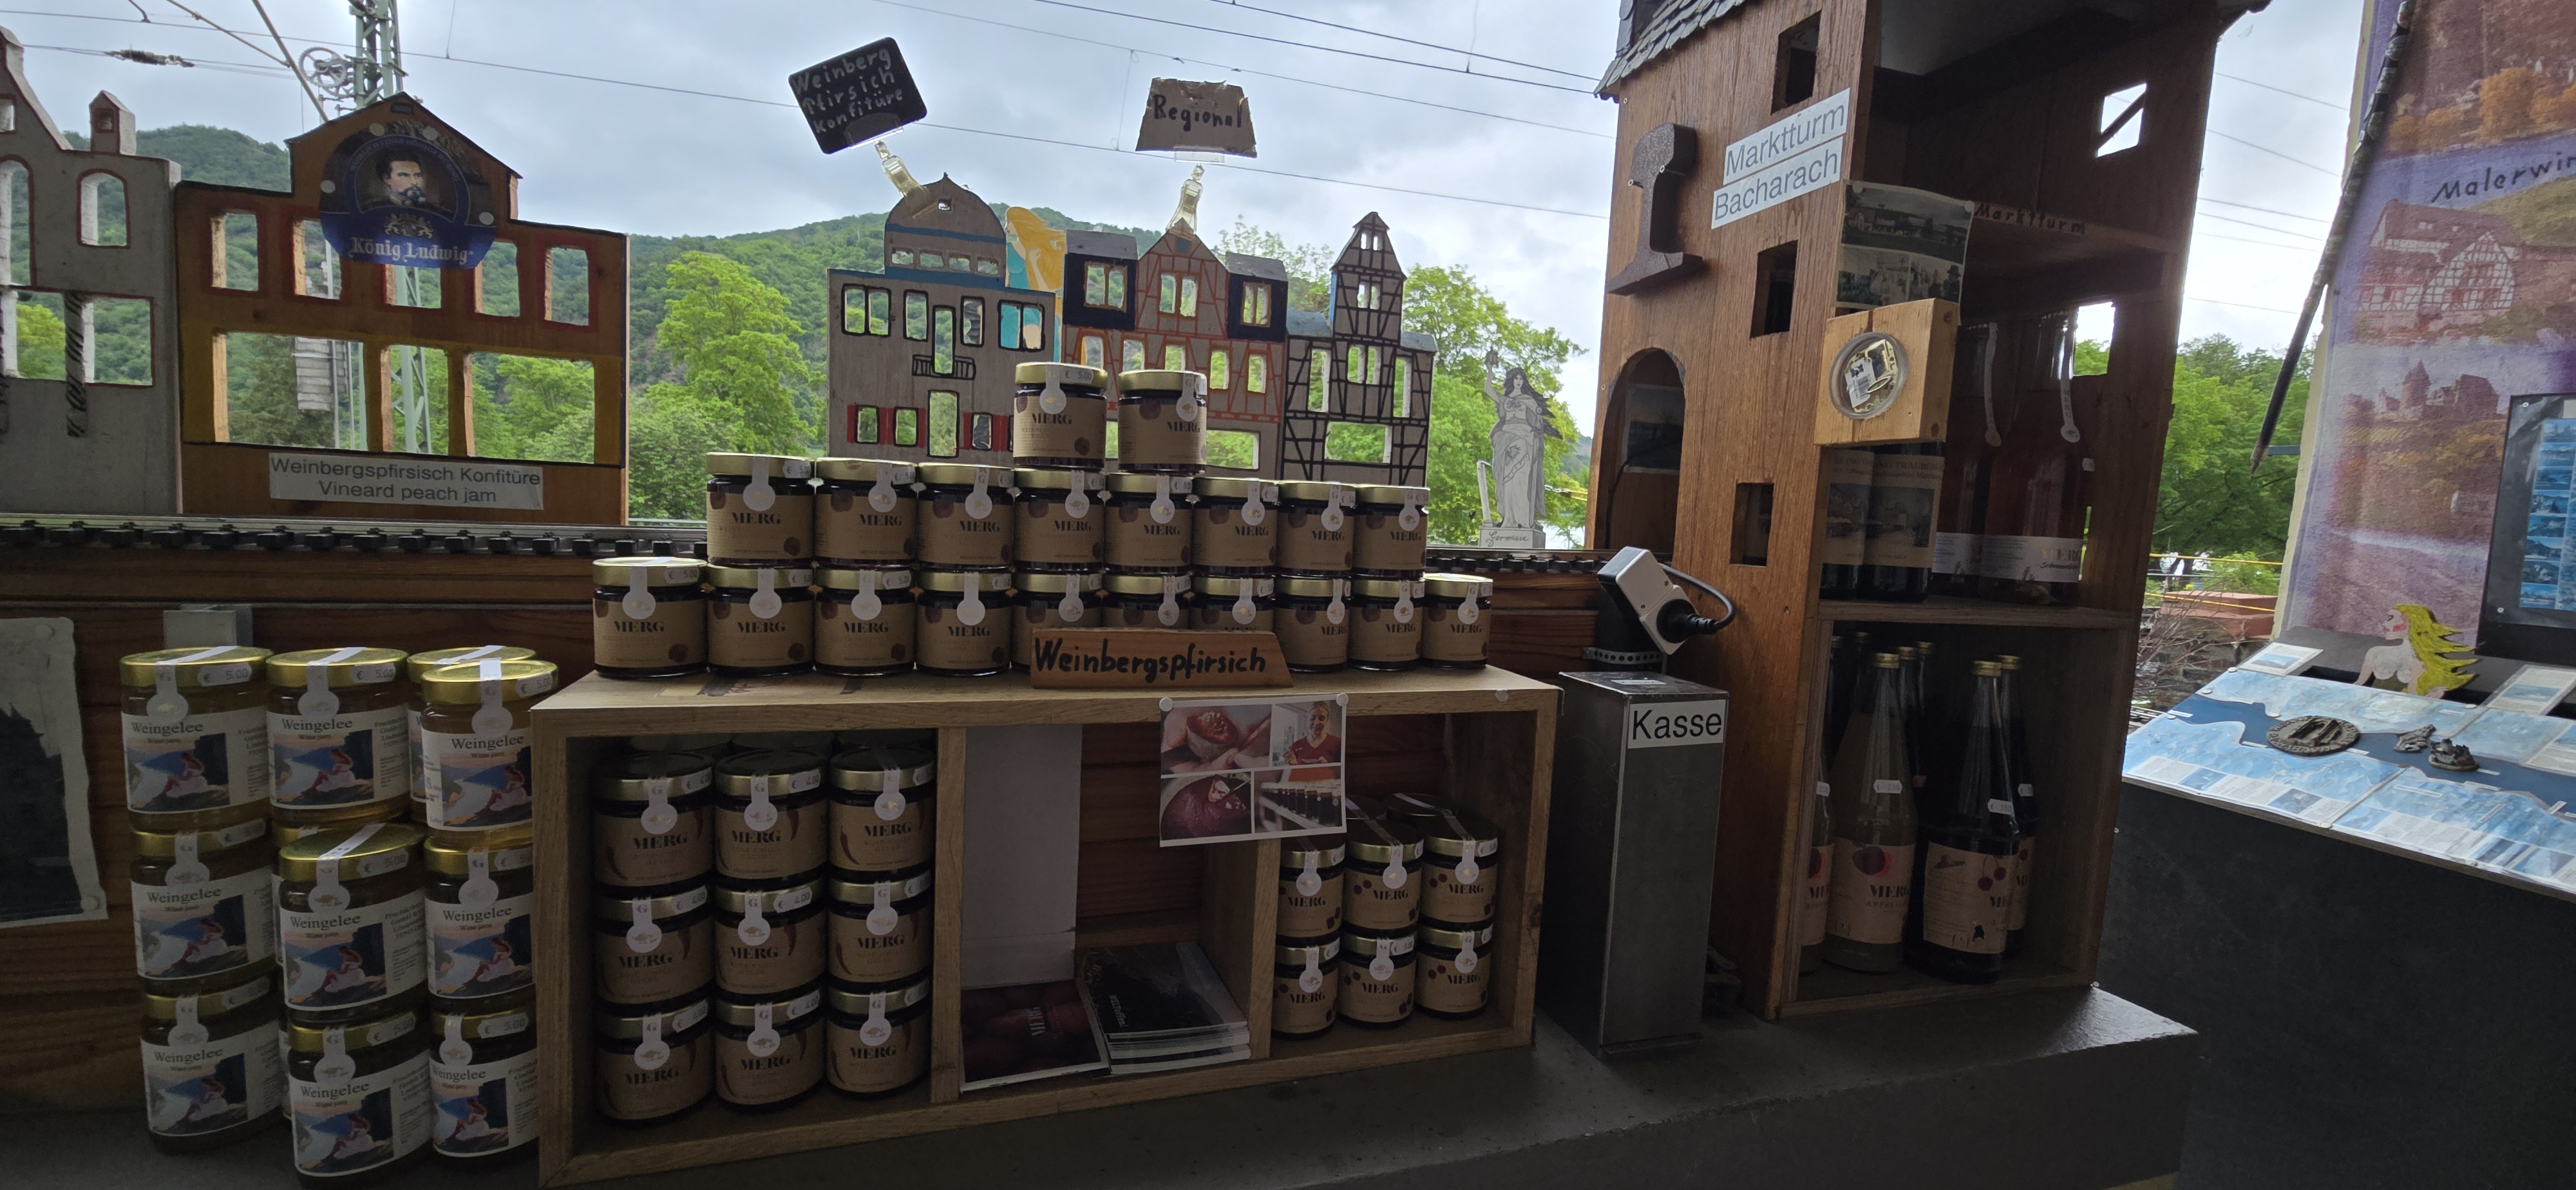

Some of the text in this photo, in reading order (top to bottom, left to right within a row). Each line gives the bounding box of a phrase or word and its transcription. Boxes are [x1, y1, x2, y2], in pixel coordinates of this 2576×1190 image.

[793, 48, 891, 95] Weinberg
[1153, 94, 1242, 128] Regional
[1725, 103, 1845, 177] Marktturm
[1714, 149, 1839, 222] Bacharach
[348, 236, 469, 264] König Ludwig
[1032, 413, 1072, 425] MERG
[1167, 422, 1200, 433] MERG
[460, 468, 540, 486] Konfitüre
[319, 480, 497, 504] Vineard peach jam
[733, 513, 781, 524] MERG
[860, 515, 902, 526] MERG
[960, 521, 999, 532] MERG
[1055, 520, 1092, 531] MERG
[1144, 525, 1180, 535] MERG
[1235, 526, 1269, 536] MERG
[1312, 531, 1344, 540] MERG
[1390, 532, 1421, 541] MERG
[615, 621, 664, 632] MERG
[738, 622, 785, 632] MERG
[844, 623, 889, 633] MERG
[949, 625, 990, 637] MERG
[1321, 625, 1349, 636] MERG
[1386, 624, 1416, 632] MERG
[1451, 625, 1482, 633] MERG
[1035, 637, 1266, 683] Weinbergspfirsich
[225, 668, 248, 681] 5.00
[356, 670, 363, 680] €
[131, 721, 204, 737] Weingelee
[281, 719, 353, 733] Weingelee
[1632, 710, 1723, 741] Kasse
[451, 735, 525, 750] Weingelee
[865, 822, 912, 836] MERG
[634, 834, 687, 849] MERG
[732, 831, 781, 843] MERG
[1374, 890, 1408, 900] MERG
[1449, 884, 1483, 894] MERG
[147, 888, 223, 904] Weingelee
[1288, 896, 1325, 907] MERG
[443, 907, 513, 923] Weingelee
[290, 915, 361, 931] Weingelee
[858, 934, 904, 949] MERG
[731, 947, 778, 959] MERG
[618, 954, 672, 968] MERG
[1448, 972, 1481, 984] MERG
[1362, 983, 1398, 993] MERG
[1289, 992, 1325, 1003] MERG
[154, 1049, 224, 1064] Weingelee
[851, 1046, 896, 1059] MERG
[741, 1056, 790, 1070] MERG
[626, 1068, 679, 1084] MERG
[301, 1082, 370, 1100] Weingelee
